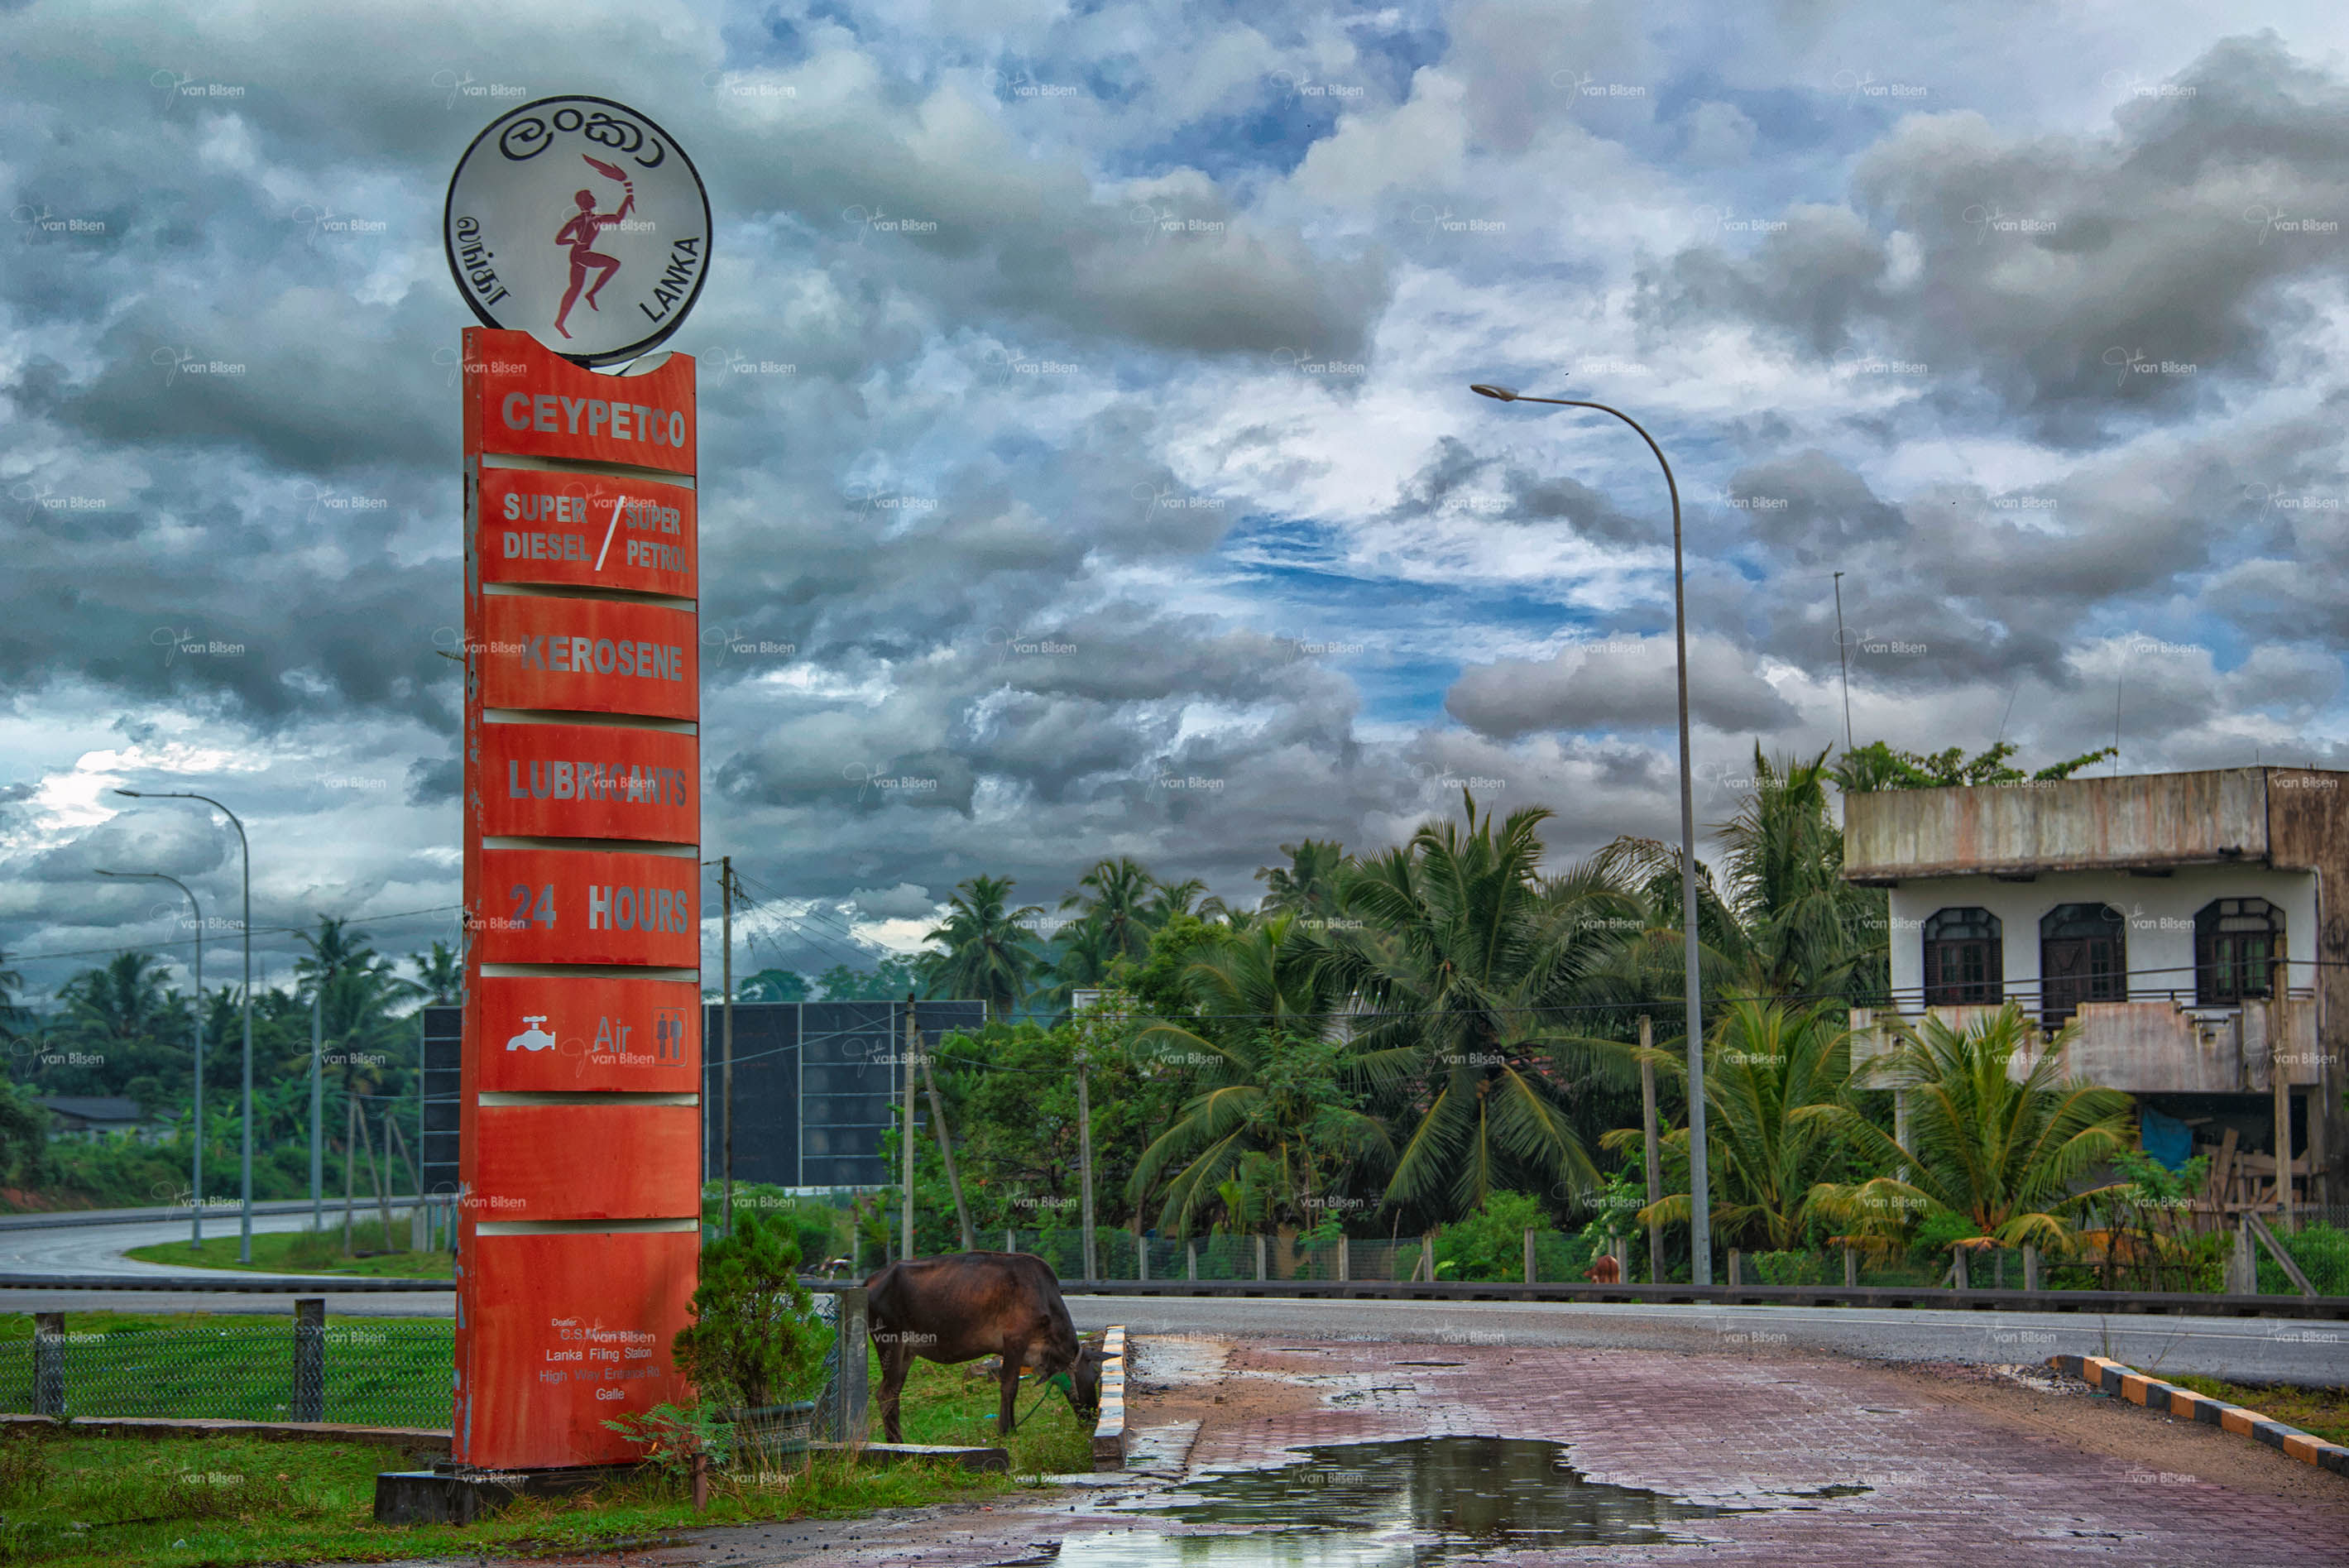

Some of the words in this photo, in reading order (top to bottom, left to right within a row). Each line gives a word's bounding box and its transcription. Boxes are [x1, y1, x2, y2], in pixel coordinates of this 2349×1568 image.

[639, 237, 701, 324] LANKA
[501, 391, 686, 448] CEYPETCO
[503, 492, 588, 524] SUPER
[626, 501, 681, 536] SUPER
[503, 531, 592, 562] DIESEL
[626, 539, 689, 573] PETROL
[520, 635, 683, 682] KEROSENE
[509, 760, 687, 807] LUBRICANTS
[509, 884, 557, 929] 24
[588, 885, 688, 934] HOURS
[592, 1016, 631, 1053] Air
[551, 1318, 578, 1327] Dealer
[545, 1349, 583, 1362] Lanka
[624, 1346, 652, 1359] Station
[539, 1370, 568, 1384] High
[573, 1369, 600, 1383] Way
[605, 1368, 645, 1380] Entrance
[596, 1388, 625, 1400] Galle
